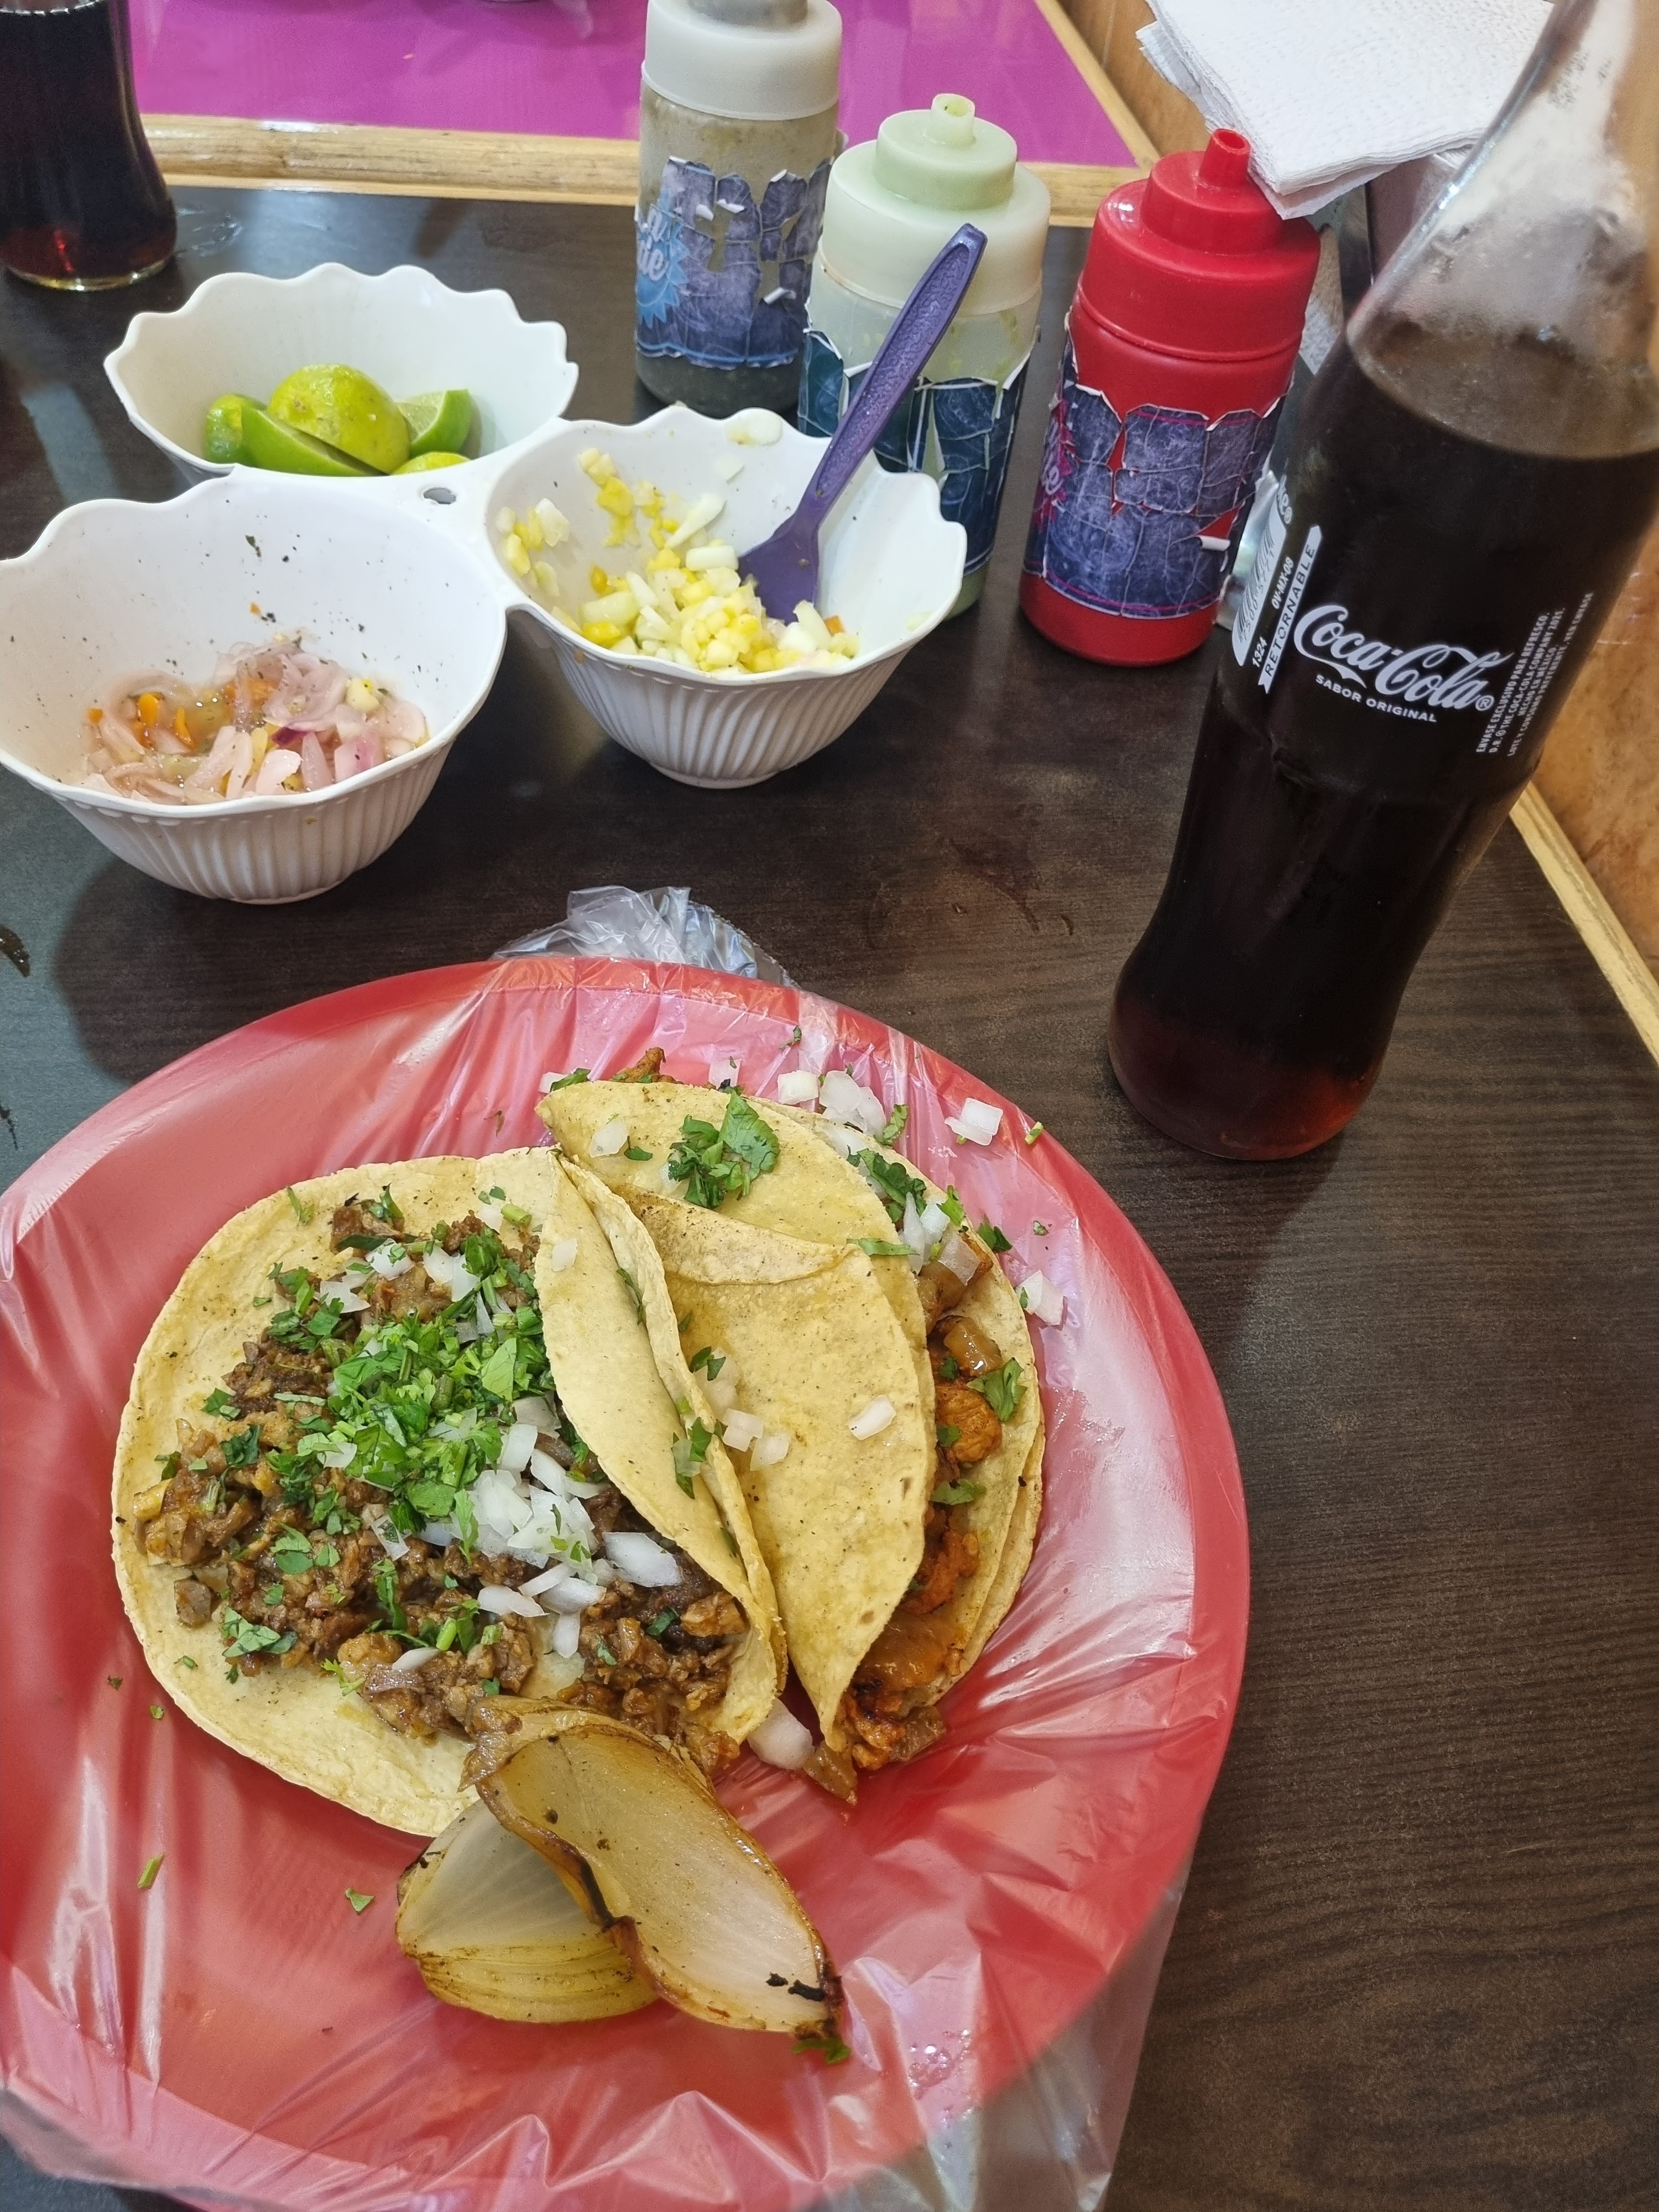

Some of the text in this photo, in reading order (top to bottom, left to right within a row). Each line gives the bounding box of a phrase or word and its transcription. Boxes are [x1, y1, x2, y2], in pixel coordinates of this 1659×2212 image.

[1252, 637, 1268, 667] 1324
[1265, 544, 1315, 677] RETORNABLE
[1315, 674, 1437, 723] SABOR ORIGINAL
[1476, 724, 1498, 753] ENVASE
[1490, 681, 1517, 723] EXCLUSIVO
[1510, 658, 1528, 680] PARA
[1500, 713, 1515, 729] THE
[1508, 670, 1535, 713] COCA-COLA
[1528, 632, 1553, 670] COMPANY
